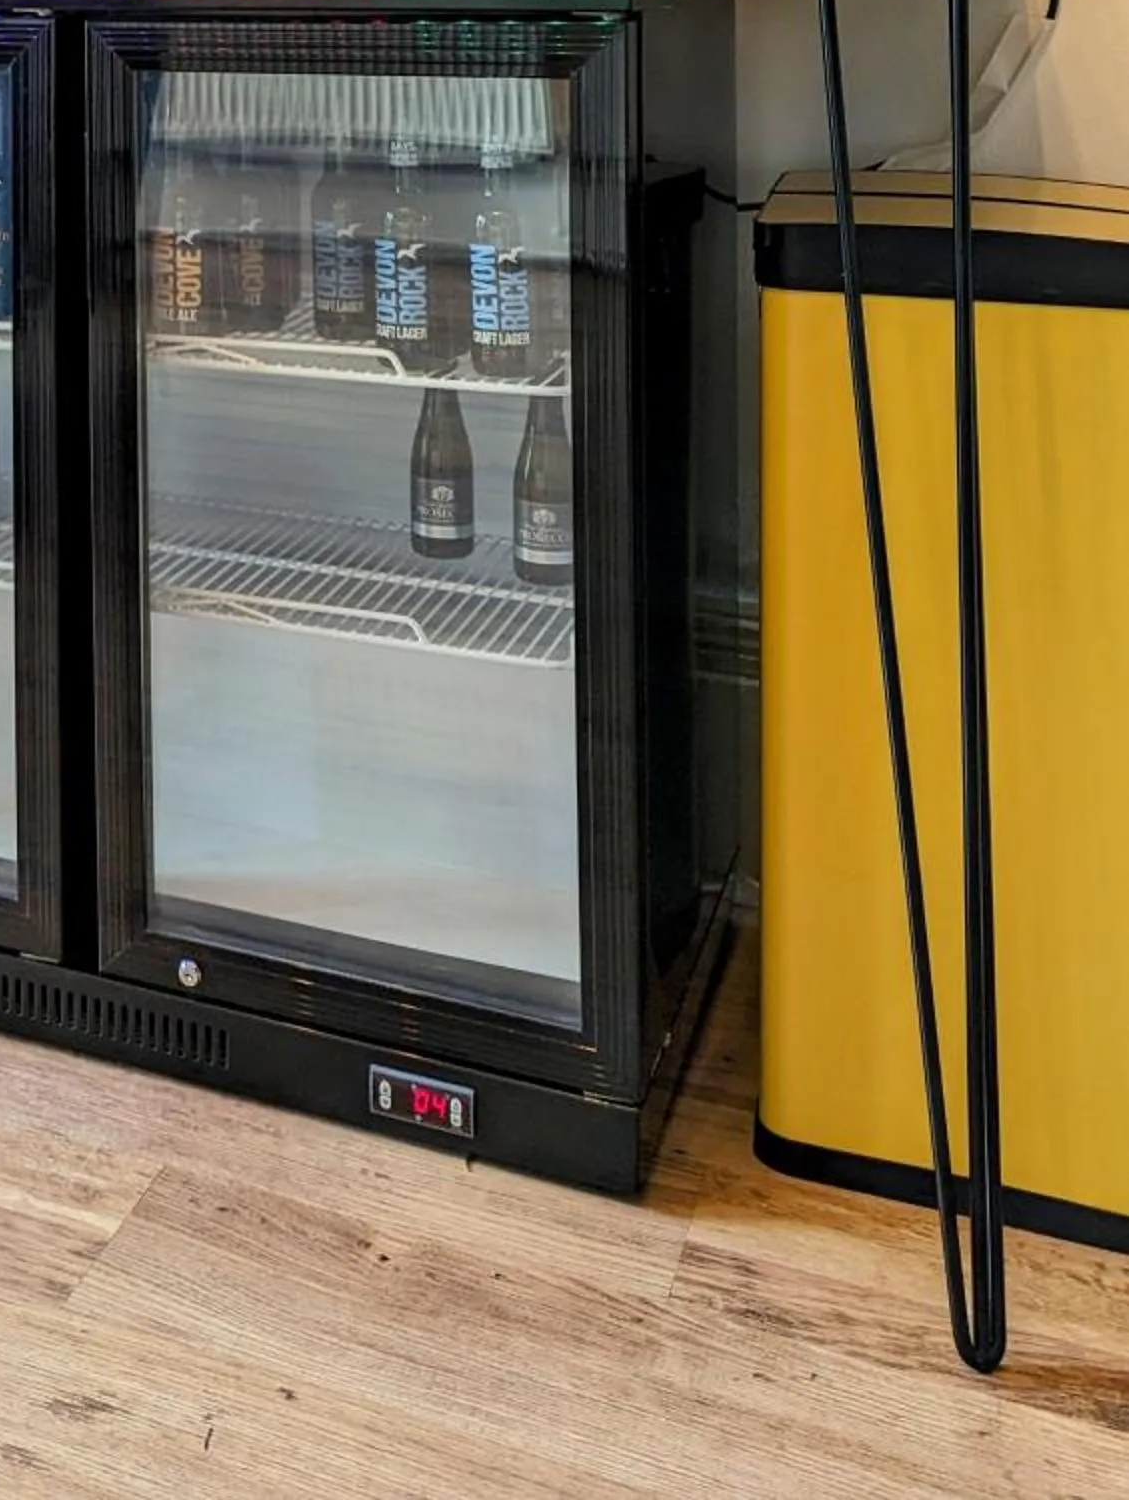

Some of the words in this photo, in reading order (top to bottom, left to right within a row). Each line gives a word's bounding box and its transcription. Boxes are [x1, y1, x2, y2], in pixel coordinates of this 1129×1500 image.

[176, 248, 202, 308] COVE
[338, 245, 365, 299] ROCK
[375, 239, 397, 323] DEVON
[398, 265, 428, 325] ROCK
[470, 243, 499, 330] DEVON
[499, 269, 530, 331] ROCK
[397, 325, 428, 341] LAGER
[499, 331, 531, 346] LAGER
[414, 1090, 448, 1118] 04
